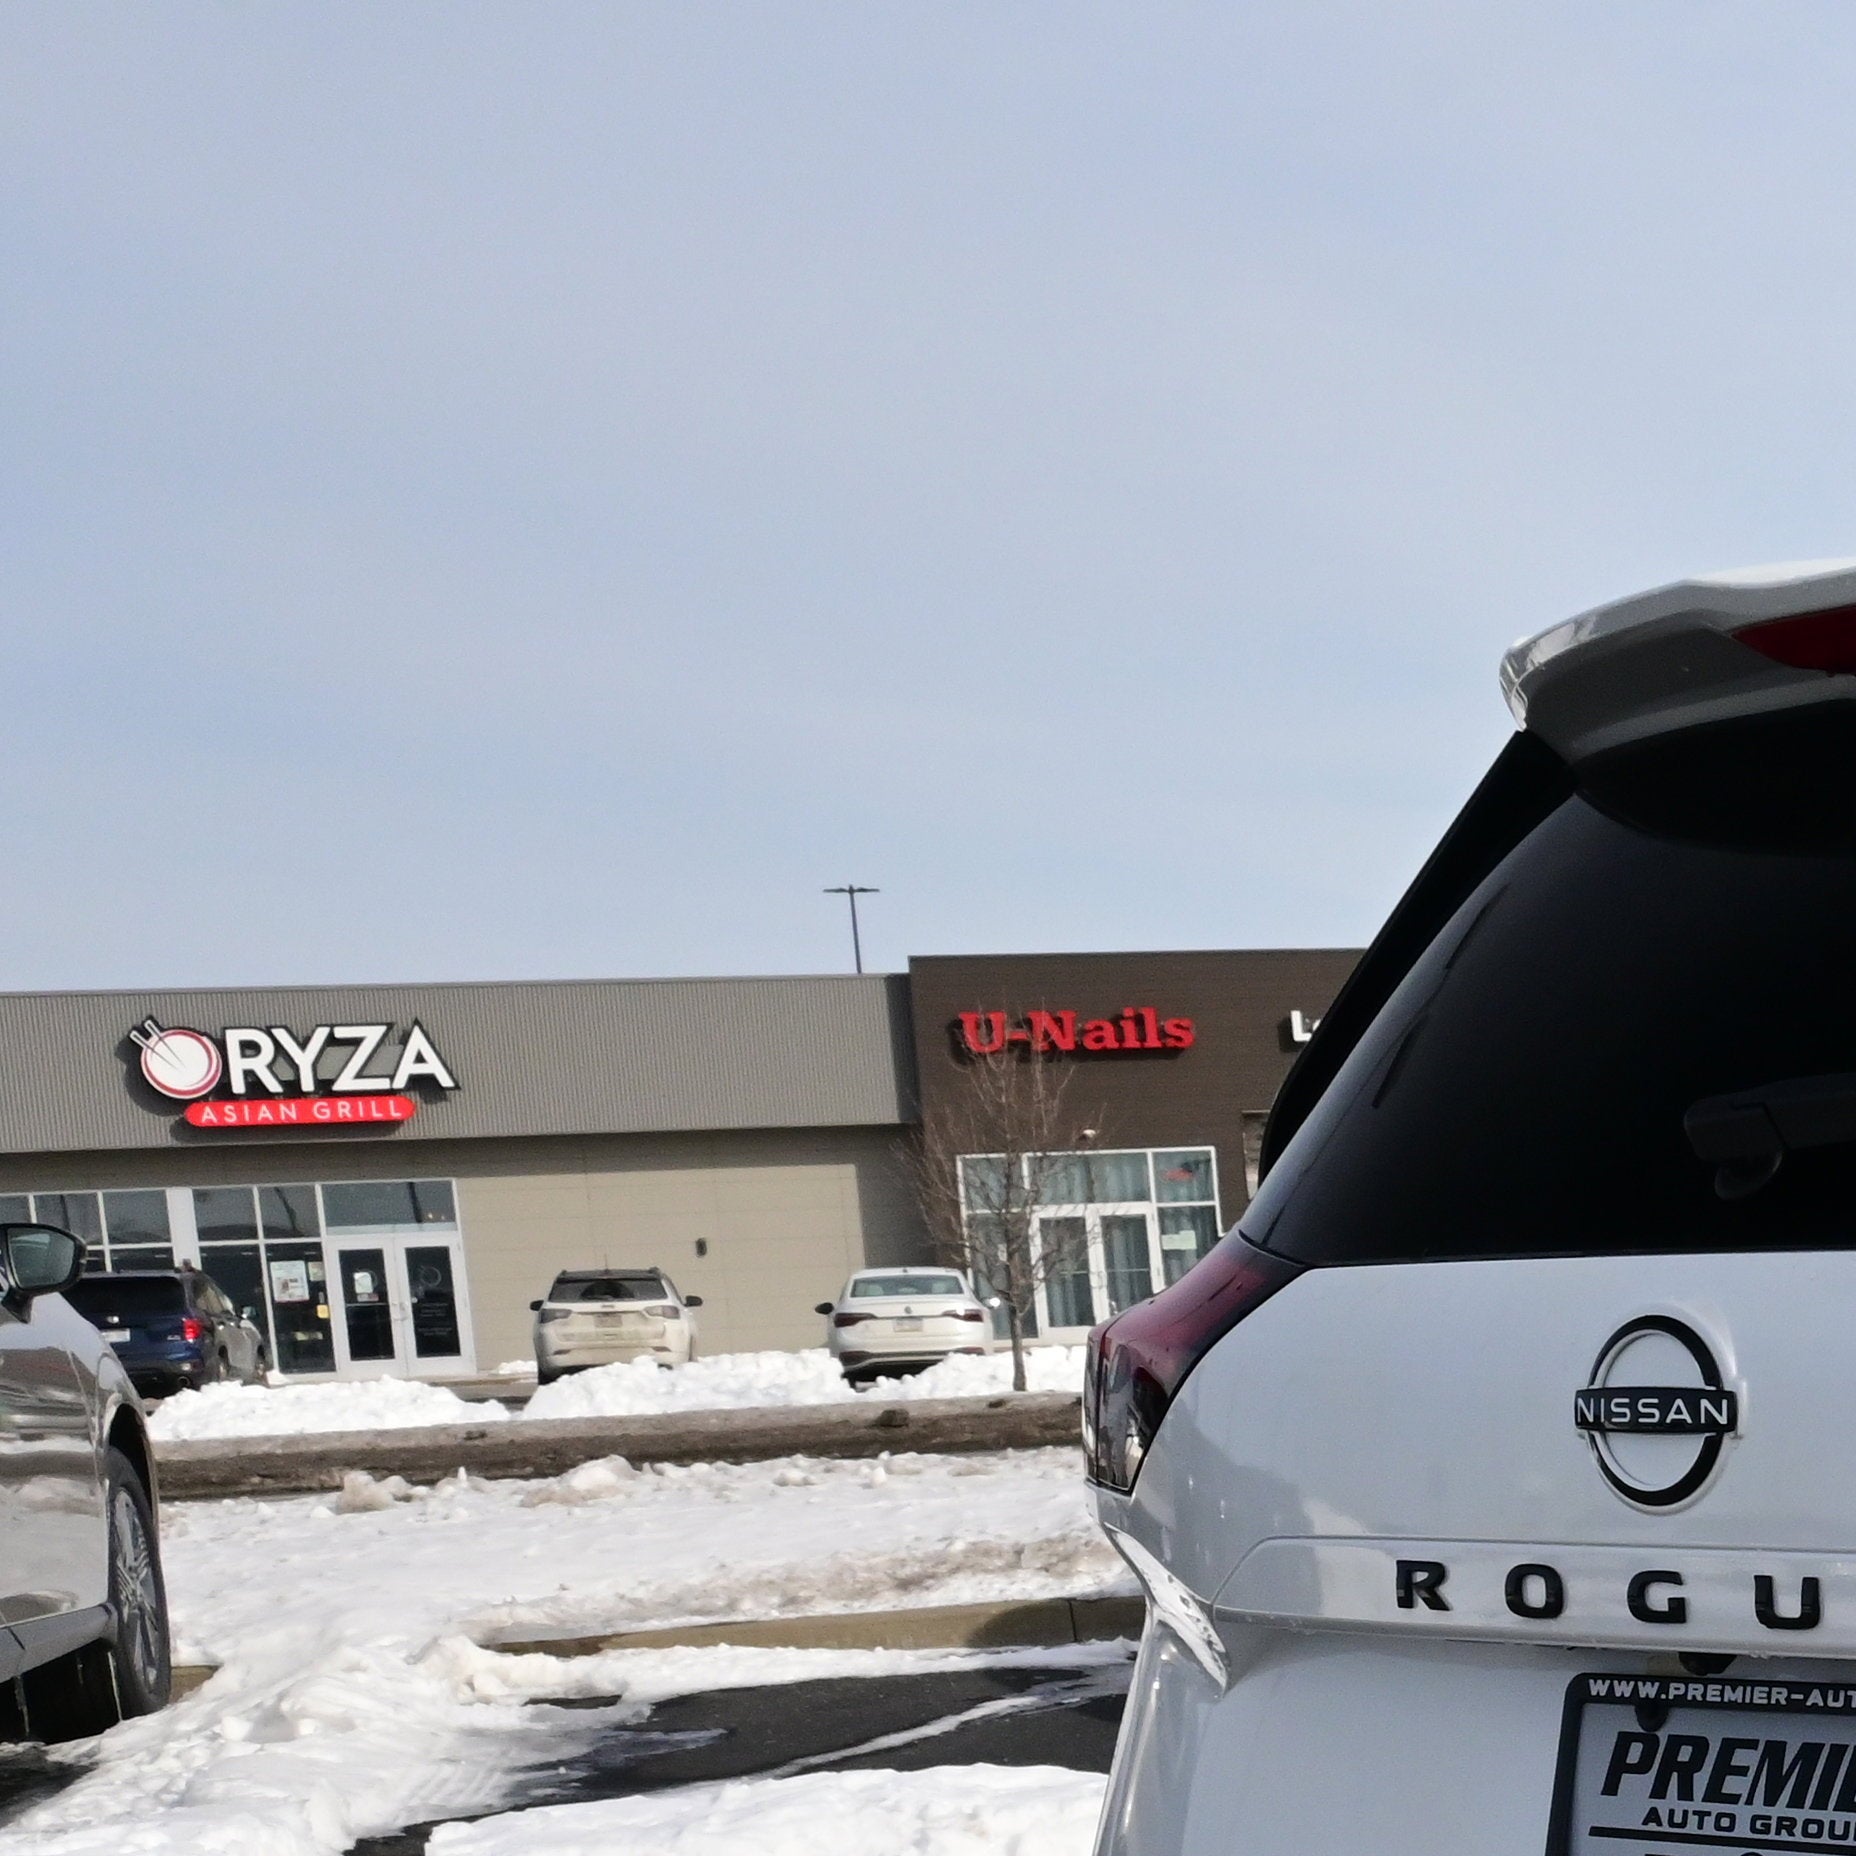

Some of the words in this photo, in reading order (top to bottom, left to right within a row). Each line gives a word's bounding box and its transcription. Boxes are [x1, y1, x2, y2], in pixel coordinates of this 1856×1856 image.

[959, 1007, 1196, 1054] U-Nails
[201, 1105, 298, 1123] ASIAN
[312, 1100, 403, 1120] GRILL
[1576, 1397, 1729, 1426] NISSAN
[1641, 1806, 1737, 1833] AUTO
